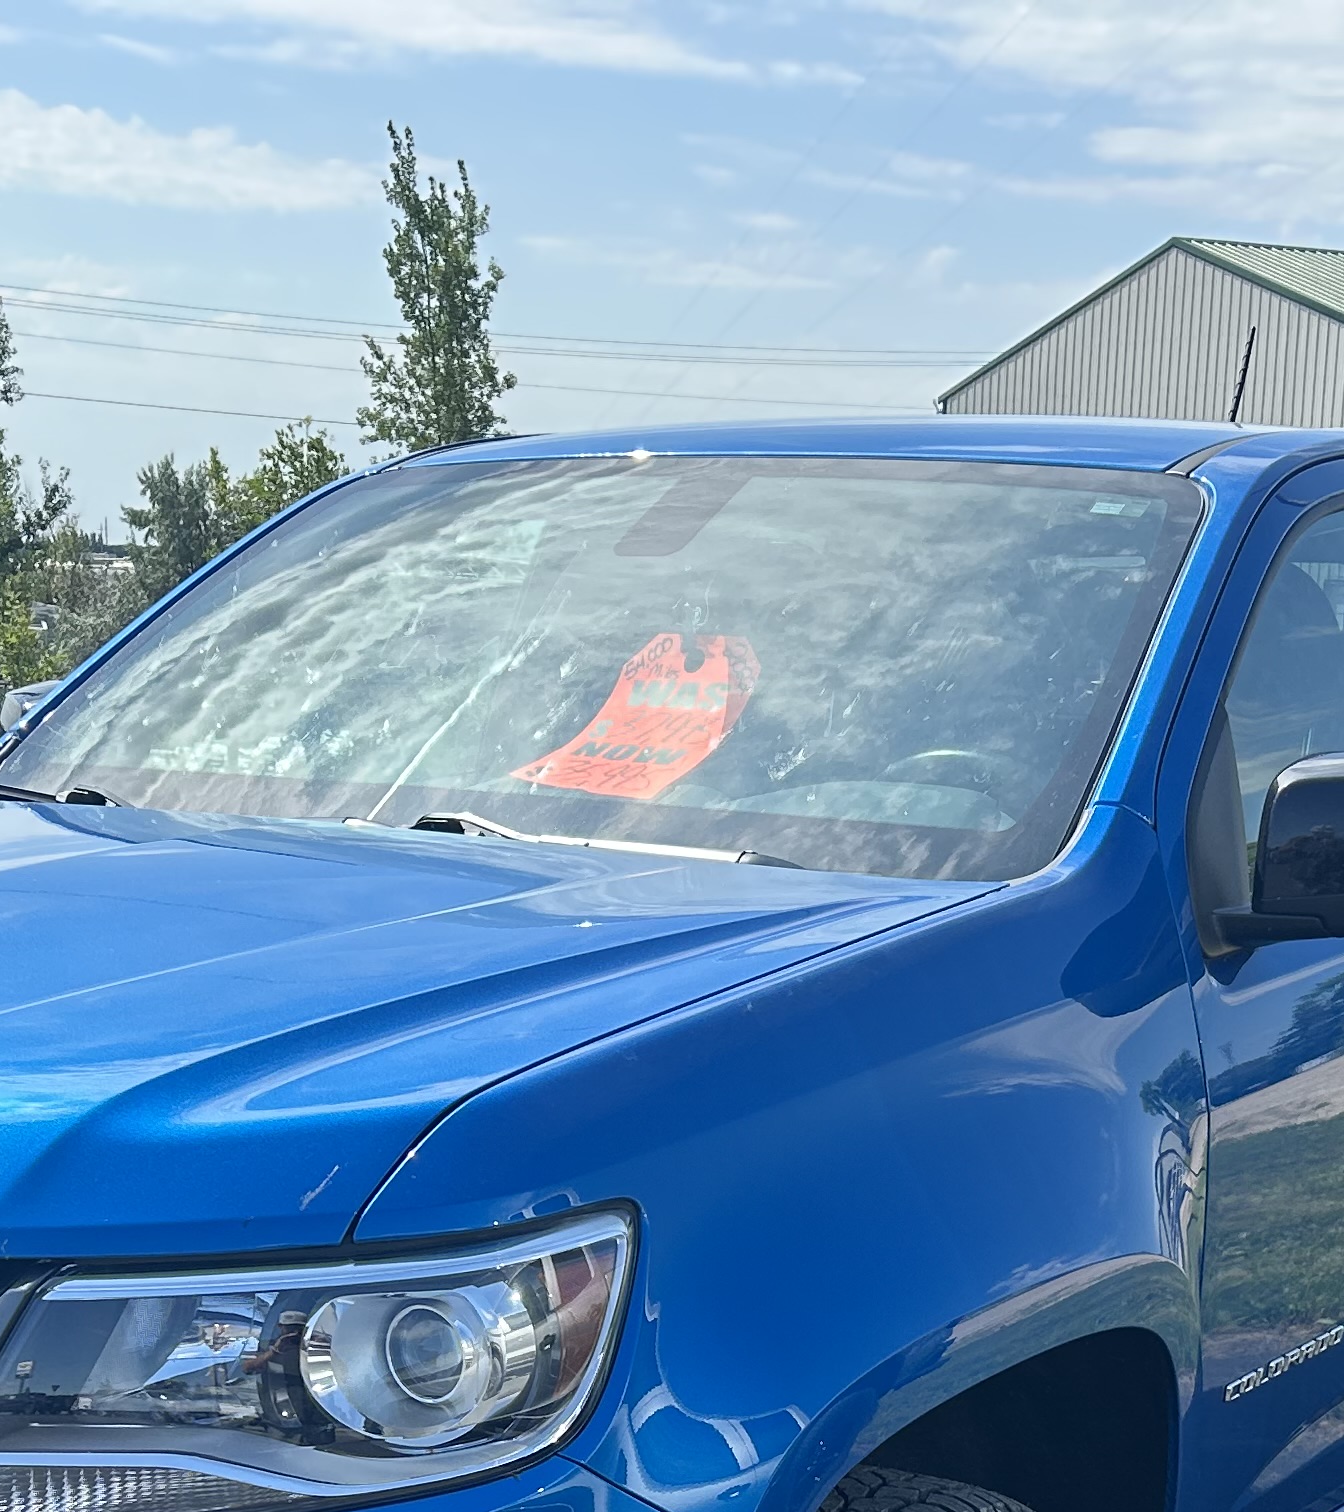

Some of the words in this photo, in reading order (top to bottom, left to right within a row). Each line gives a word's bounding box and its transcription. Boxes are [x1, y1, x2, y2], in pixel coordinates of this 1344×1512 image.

[627, 680, 731, 710] WAS
[570, 741, 688, 765] NOW
[1224, 1324, 1344, 1402] COLORADO
